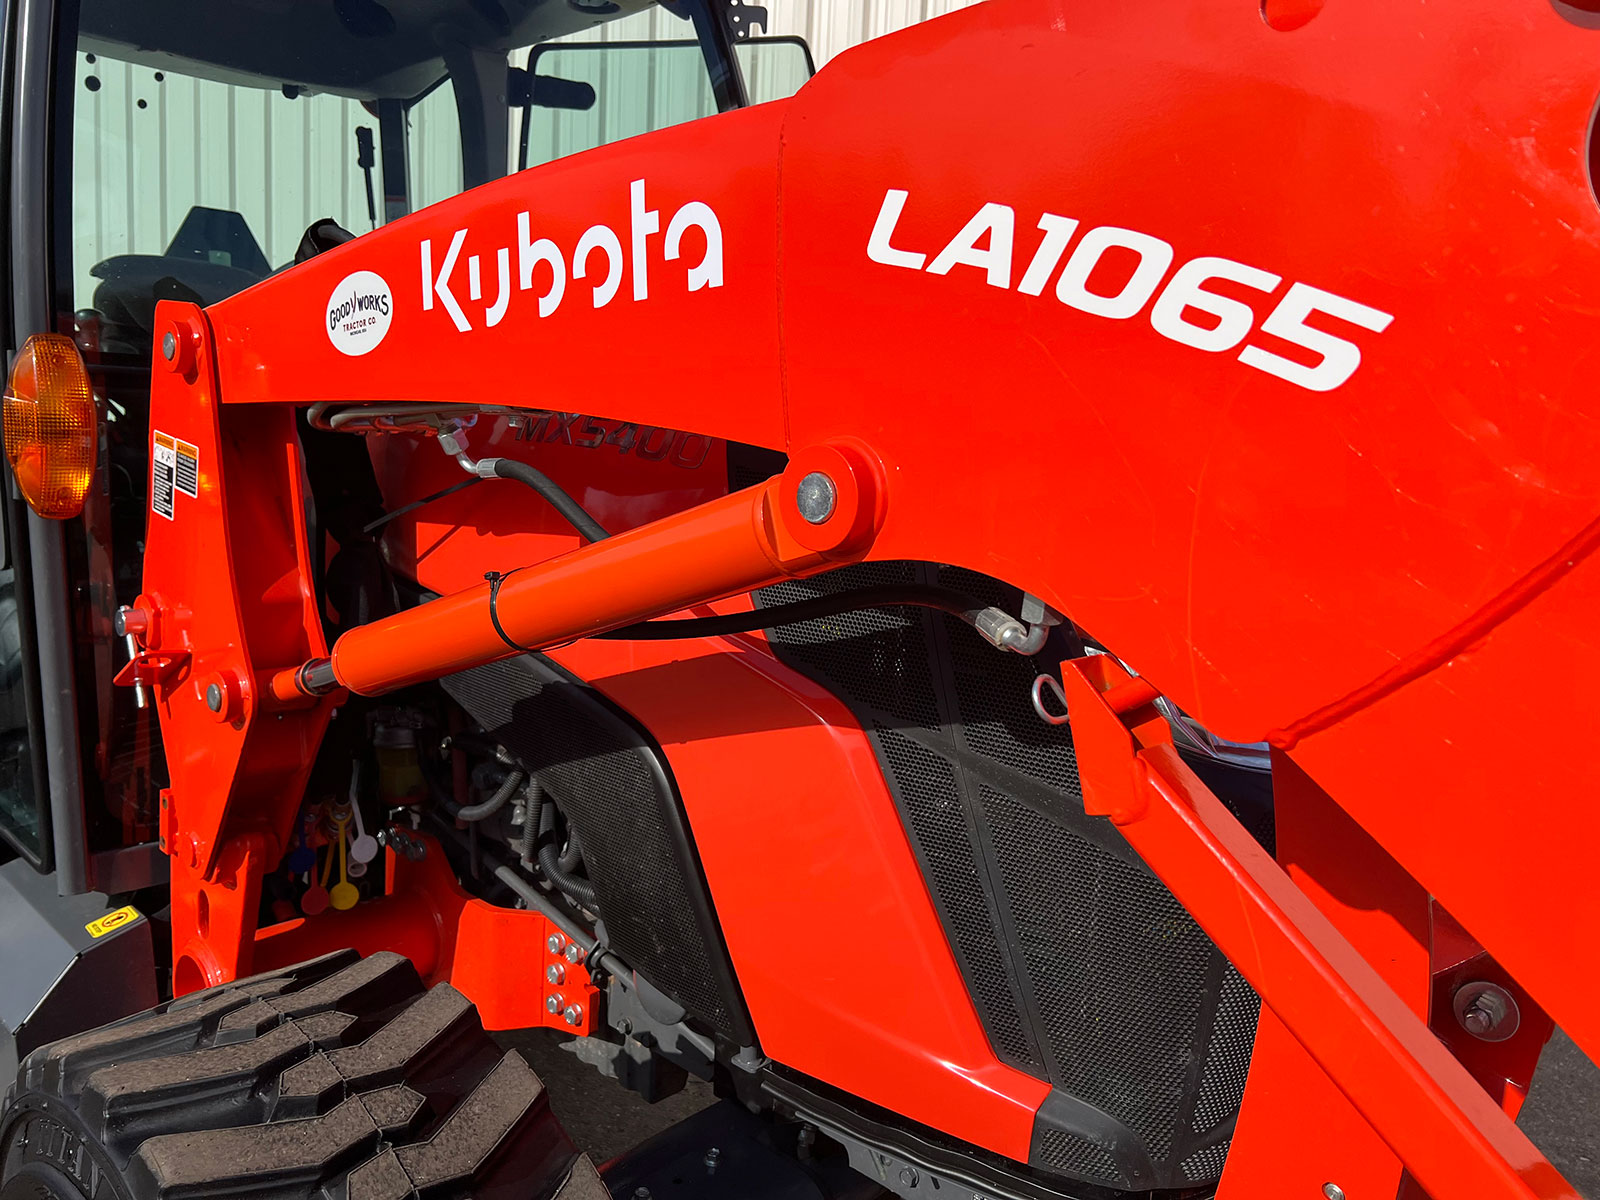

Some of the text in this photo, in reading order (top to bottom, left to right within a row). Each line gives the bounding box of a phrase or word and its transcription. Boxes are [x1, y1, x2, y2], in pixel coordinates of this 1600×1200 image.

[421, 179, 723, 332] Kubota
[867, 190, 1394, 391] LA1065
[343, 318, 367, 332] TRACTOR
[514, 411, 713, 469] MX5400
